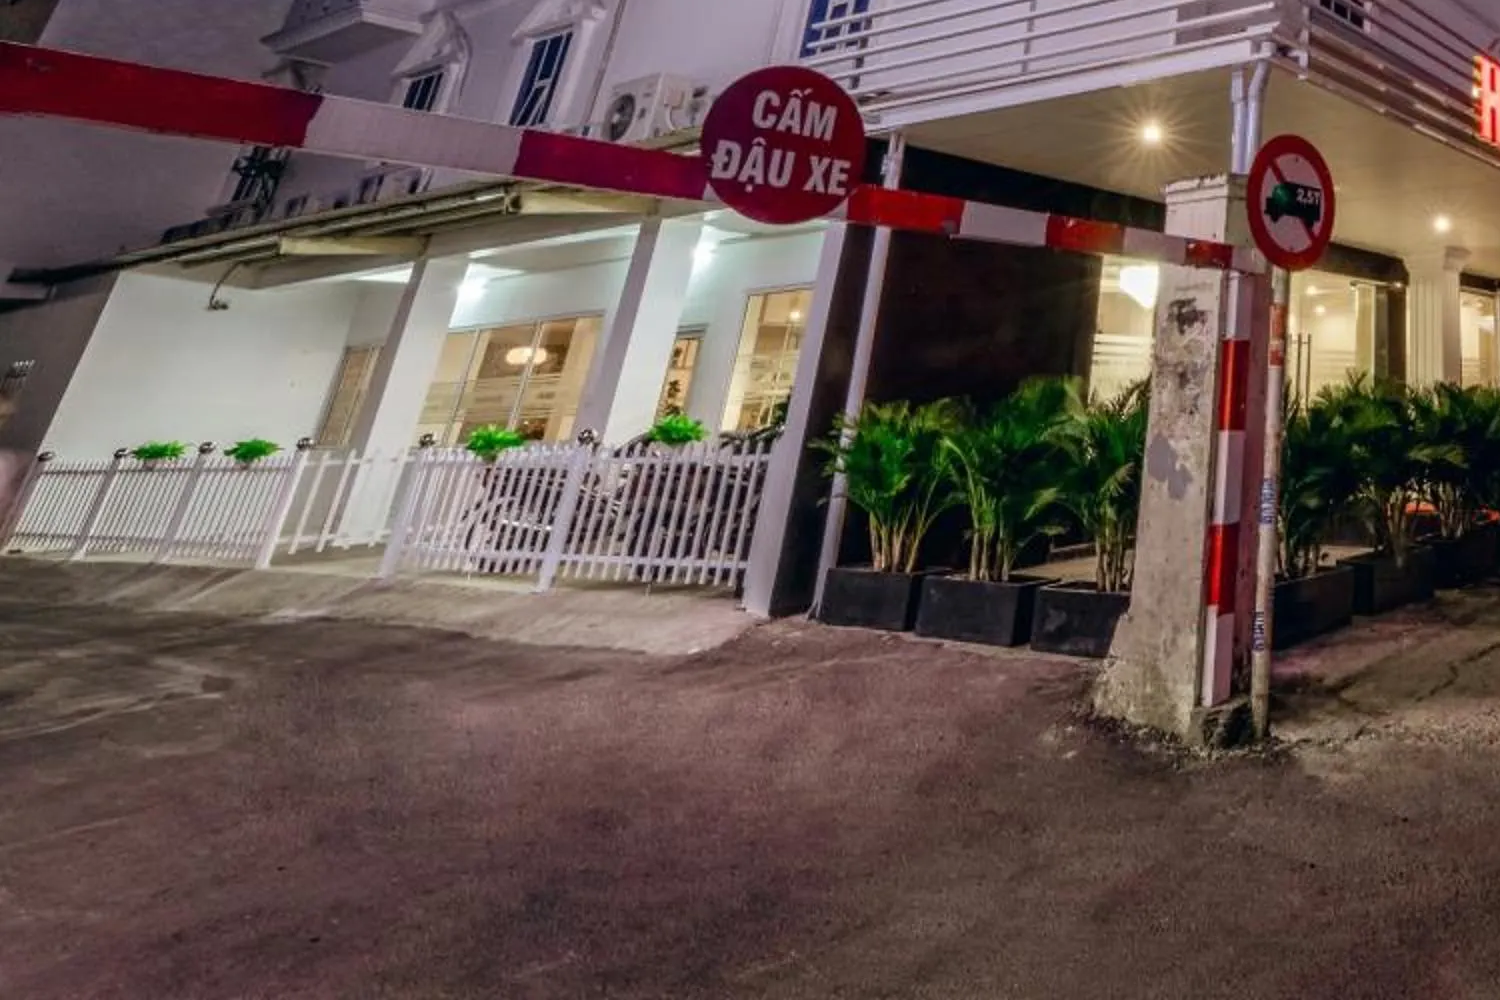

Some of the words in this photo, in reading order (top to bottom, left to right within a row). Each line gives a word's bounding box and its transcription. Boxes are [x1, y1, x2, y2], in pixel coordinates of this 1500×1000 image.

[752, 88, 838, 141] CẤM
[711, 137, 796, 193] ĐẬU
[803, 155, 851, 196] XE
